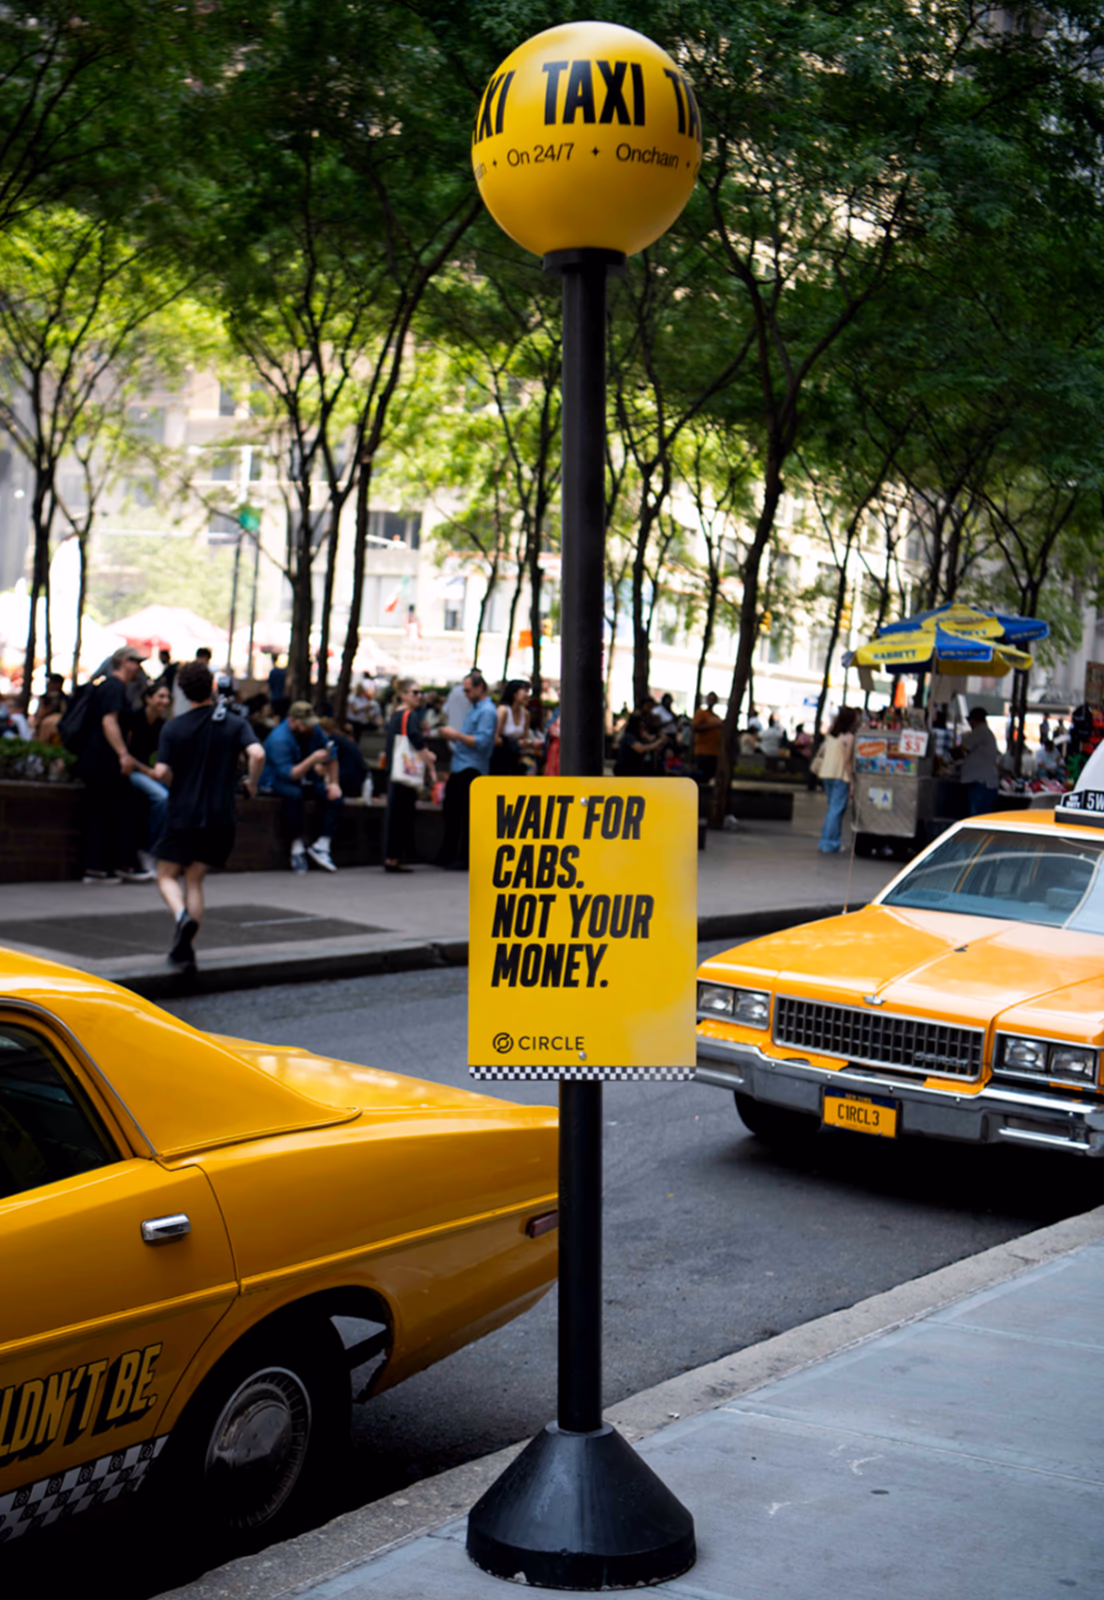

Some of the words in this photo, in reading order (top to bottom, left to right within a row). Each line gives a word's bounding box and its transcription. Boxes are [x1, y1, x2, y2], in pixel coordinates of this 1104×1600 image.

[542, 60, 646, 126] TAXI
[507, 149, 530, 167] On
[533, 143, 575, 163] 24/7
[616, 143, 680, 169] Onchain
[496, 795, 575, 840] WAIT
[583, 795, 646, 840] FOR
[492, 844, 585, 889] CABS.
[491, 894, 557, 938] NOT
[569, 894, 655, 939] YOUR
[491, 943, 609, 988] MONEY.
[518, 1036, 585, 1051] CIRCLE
[97, 1342, 163, 1433] BE.
